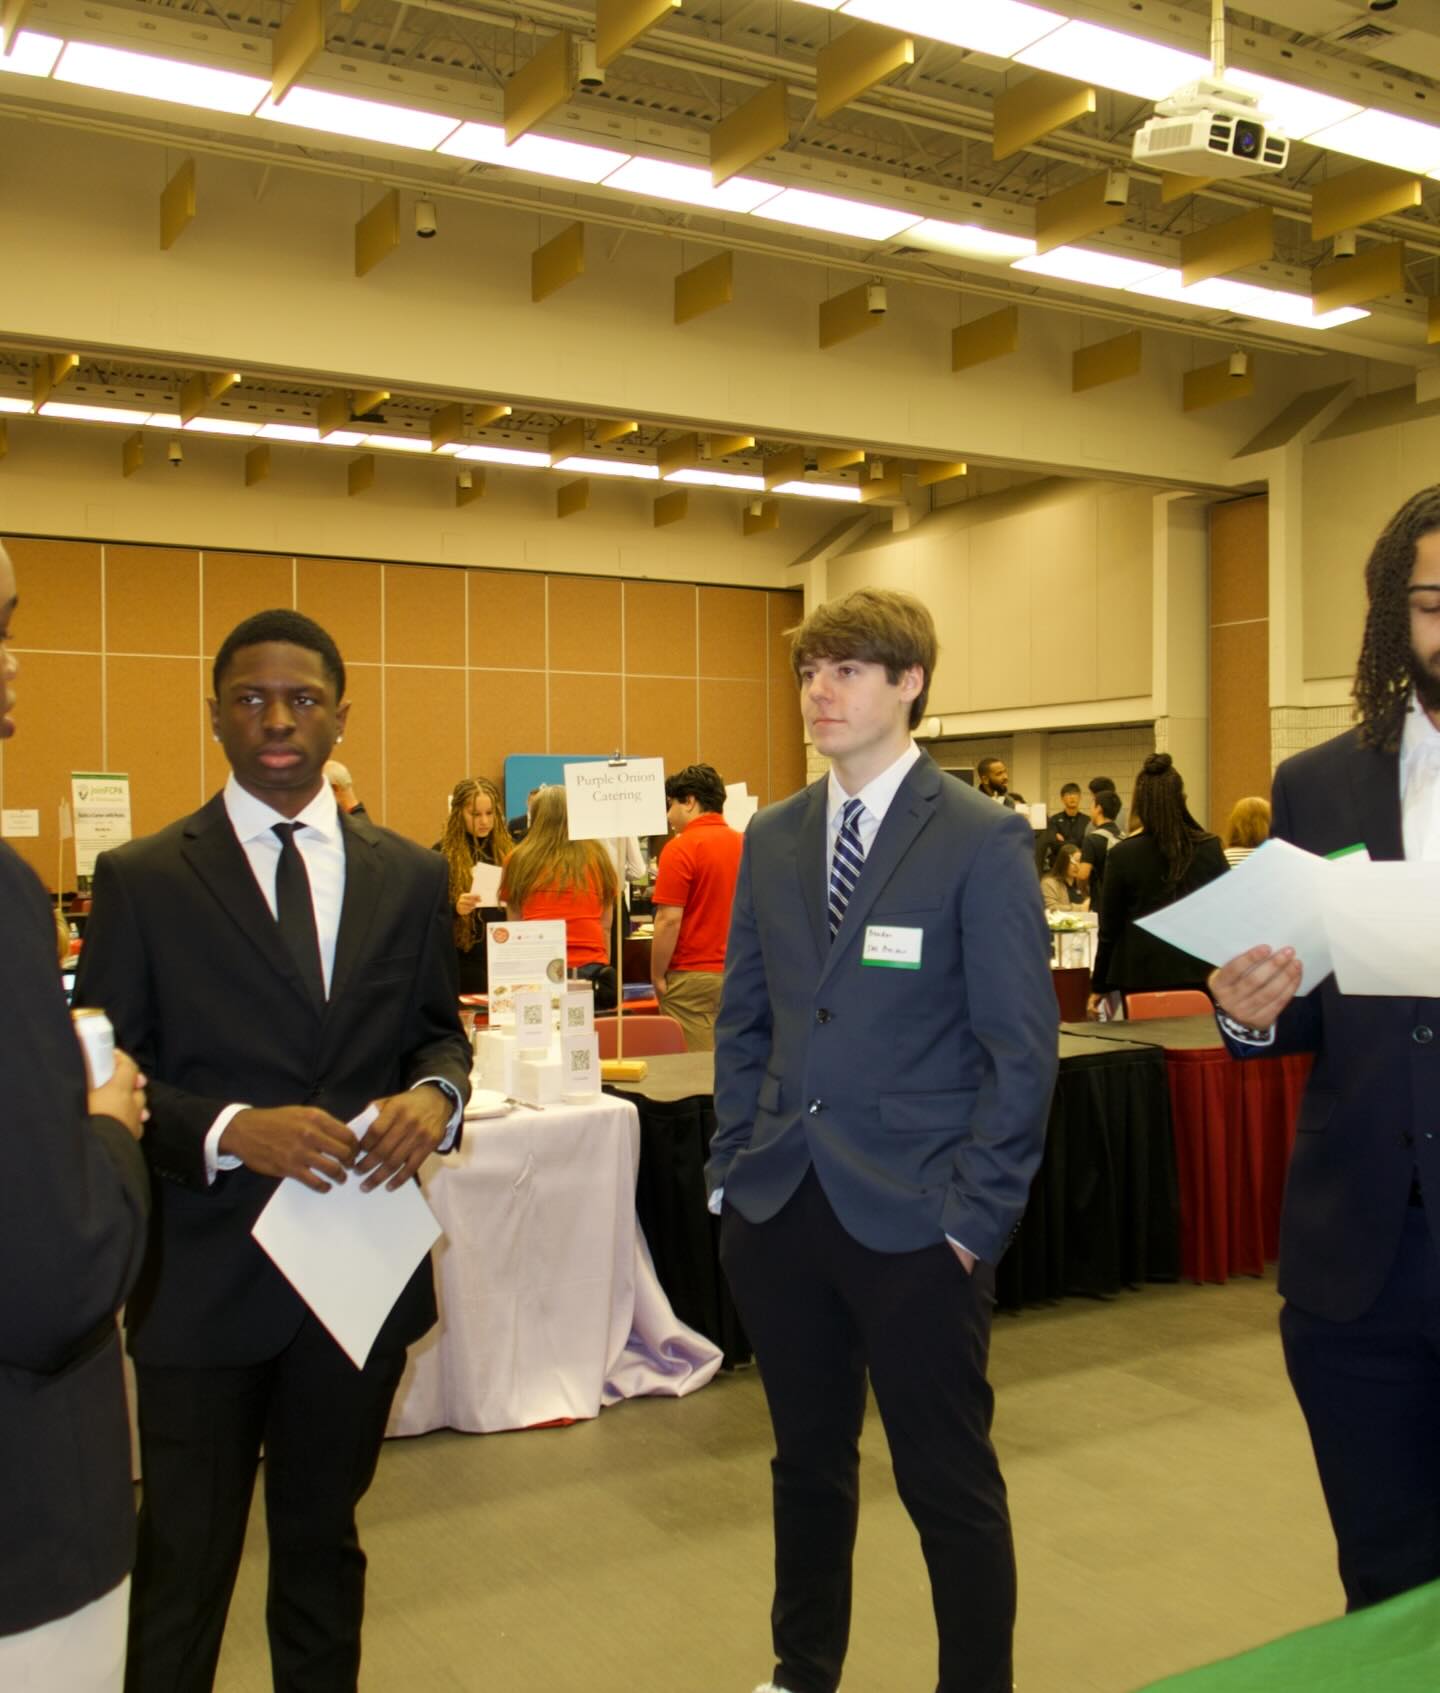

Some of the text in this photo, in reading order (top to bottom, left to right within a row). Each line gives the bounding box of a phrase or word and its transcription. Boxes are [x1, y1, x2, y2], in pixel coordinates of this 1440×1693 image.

[577, 772, 656, 788] Purple Onion
[592, 790, 642, 802] Catering
